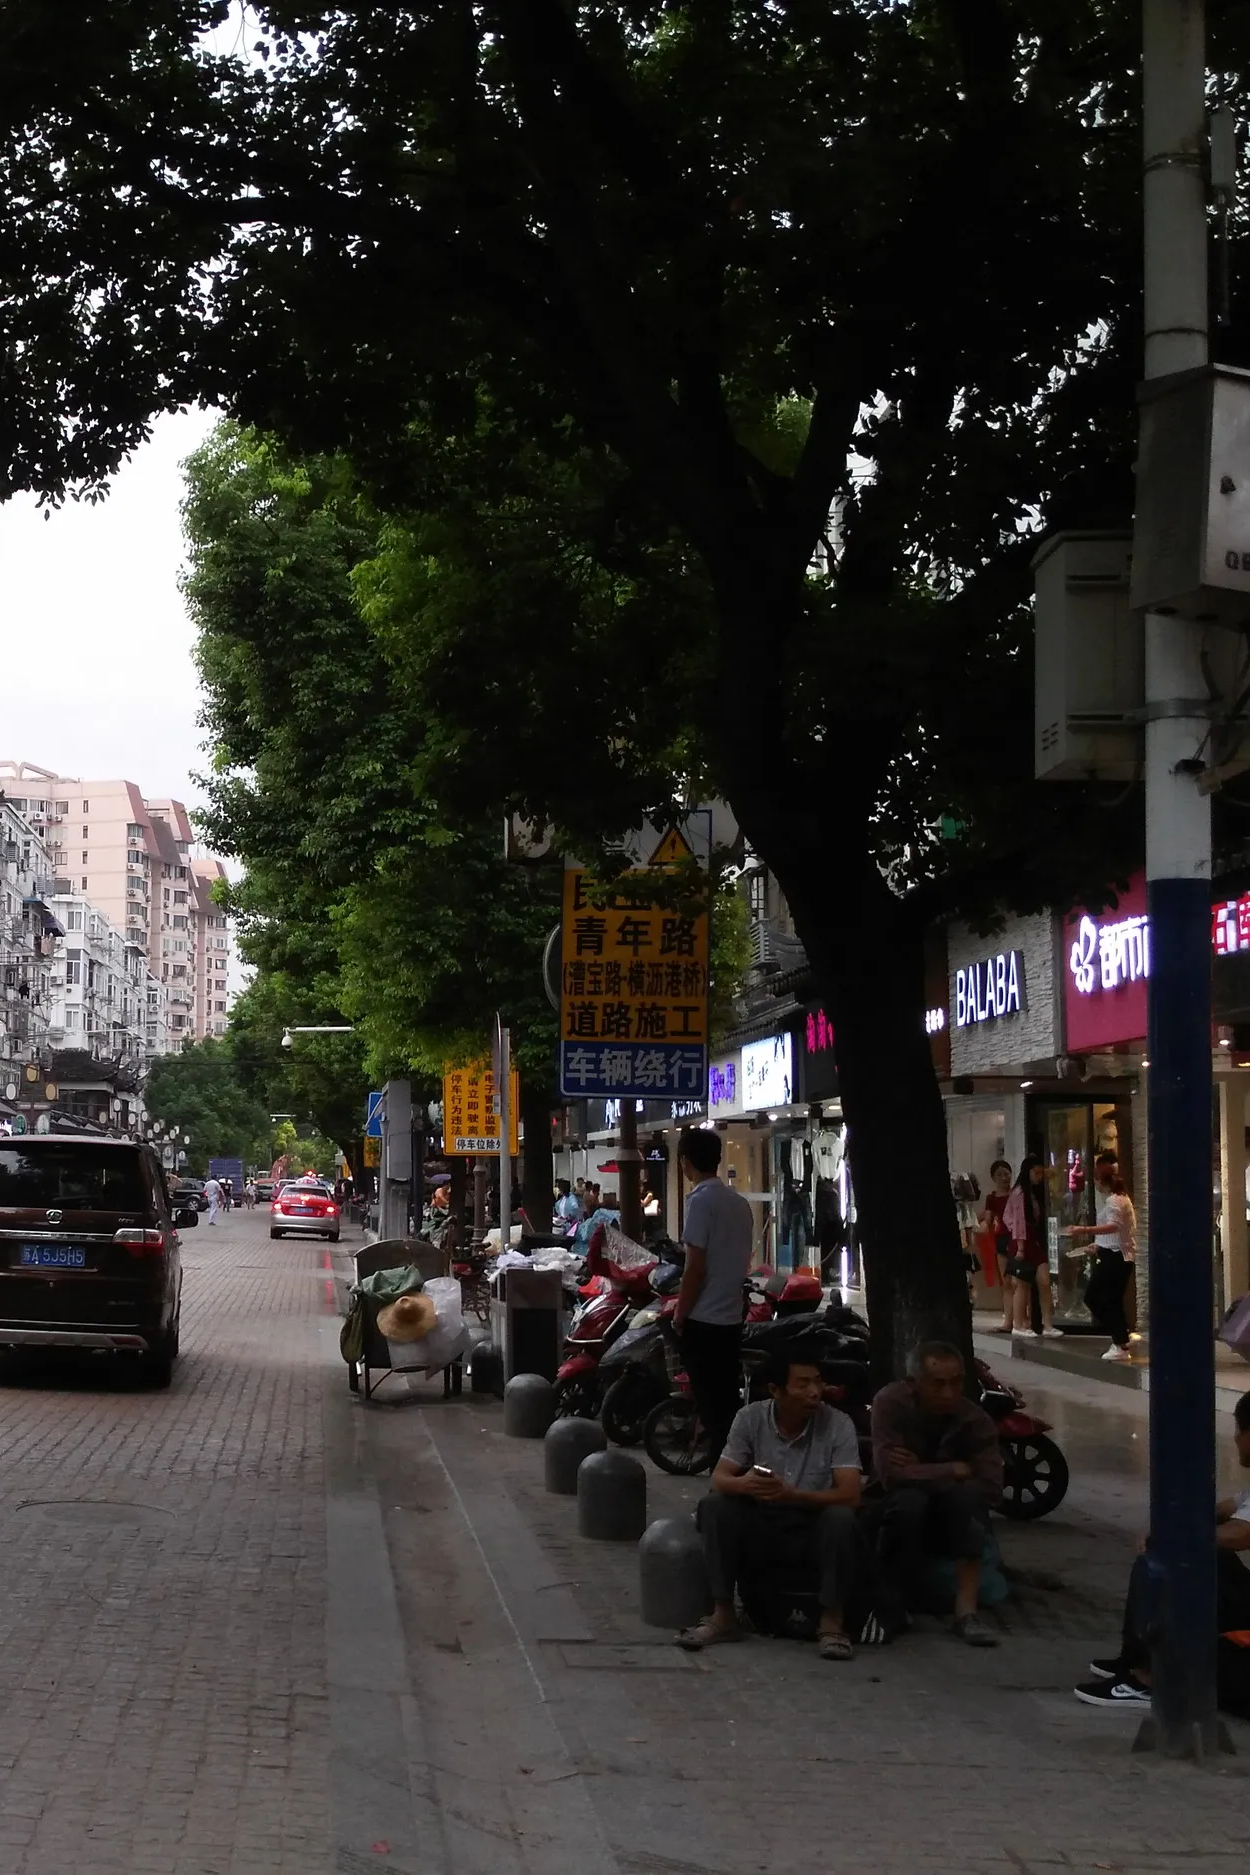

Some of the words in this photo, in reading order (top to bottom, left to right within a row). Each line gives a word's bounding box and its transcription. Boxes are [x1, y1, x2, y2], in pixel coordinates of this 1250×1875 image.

[572, 915, 698, 957] 青年路
[1098, 914, 1149, 989] 都市
[956, 949, 1020, 1027] BALABA
[566, 1001, 703, 1039] 道路施工
[565, 1046, 703, 1089] 车辆绕行
[450, 1073, 463, 1136] 停车行为违法
[467, 1075, 479, 1136] 请立即驶离
